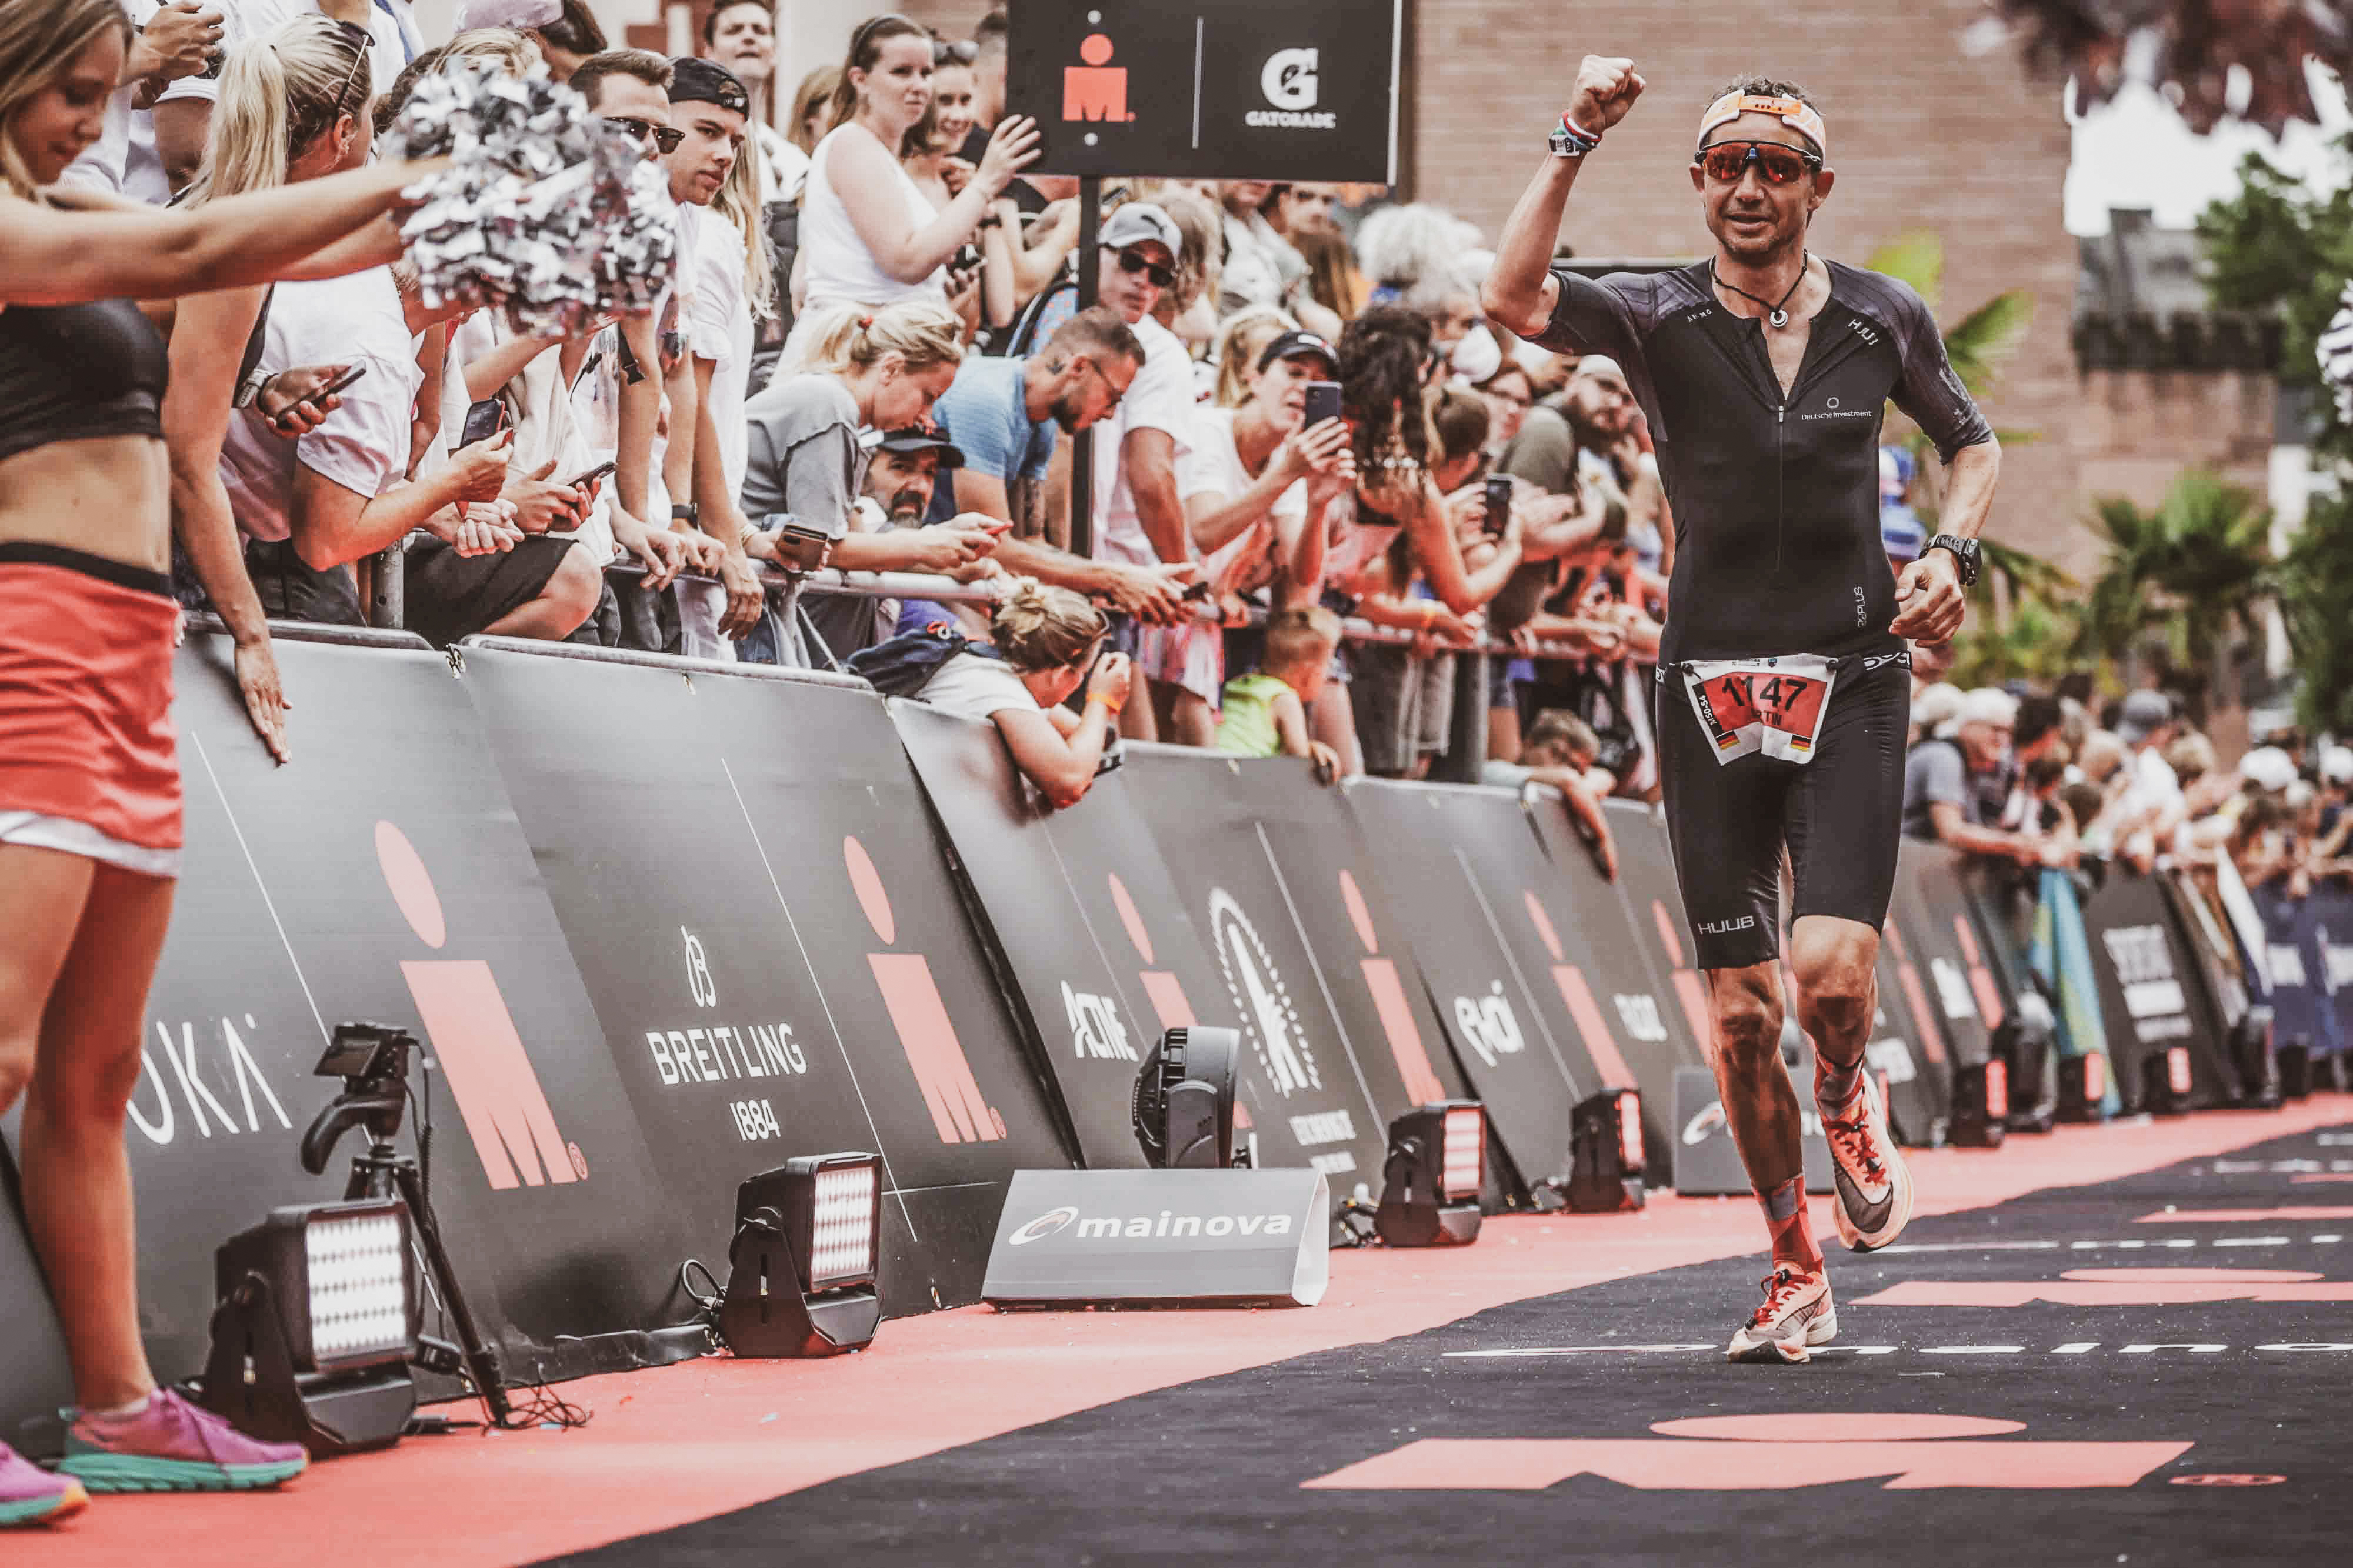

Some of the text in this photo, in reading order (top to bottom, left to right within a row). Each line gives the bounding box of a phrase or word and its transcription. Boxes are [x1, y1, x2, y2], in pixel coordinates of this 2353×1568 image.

[1802, 412, 1832, 421] Deutsche
[1698, 694, 1717, 725] M50-54
[1722, 675, 1808, 712] 1147
[1698, 916, 1755, 935] HUUB
[646, 1023, 808, 1085] BREITLING
[126, 1013, 292, 1145] OKA
[729, 1099, 782, 1141] 1884
[1076, 1210, 1292, 1238] mainova
